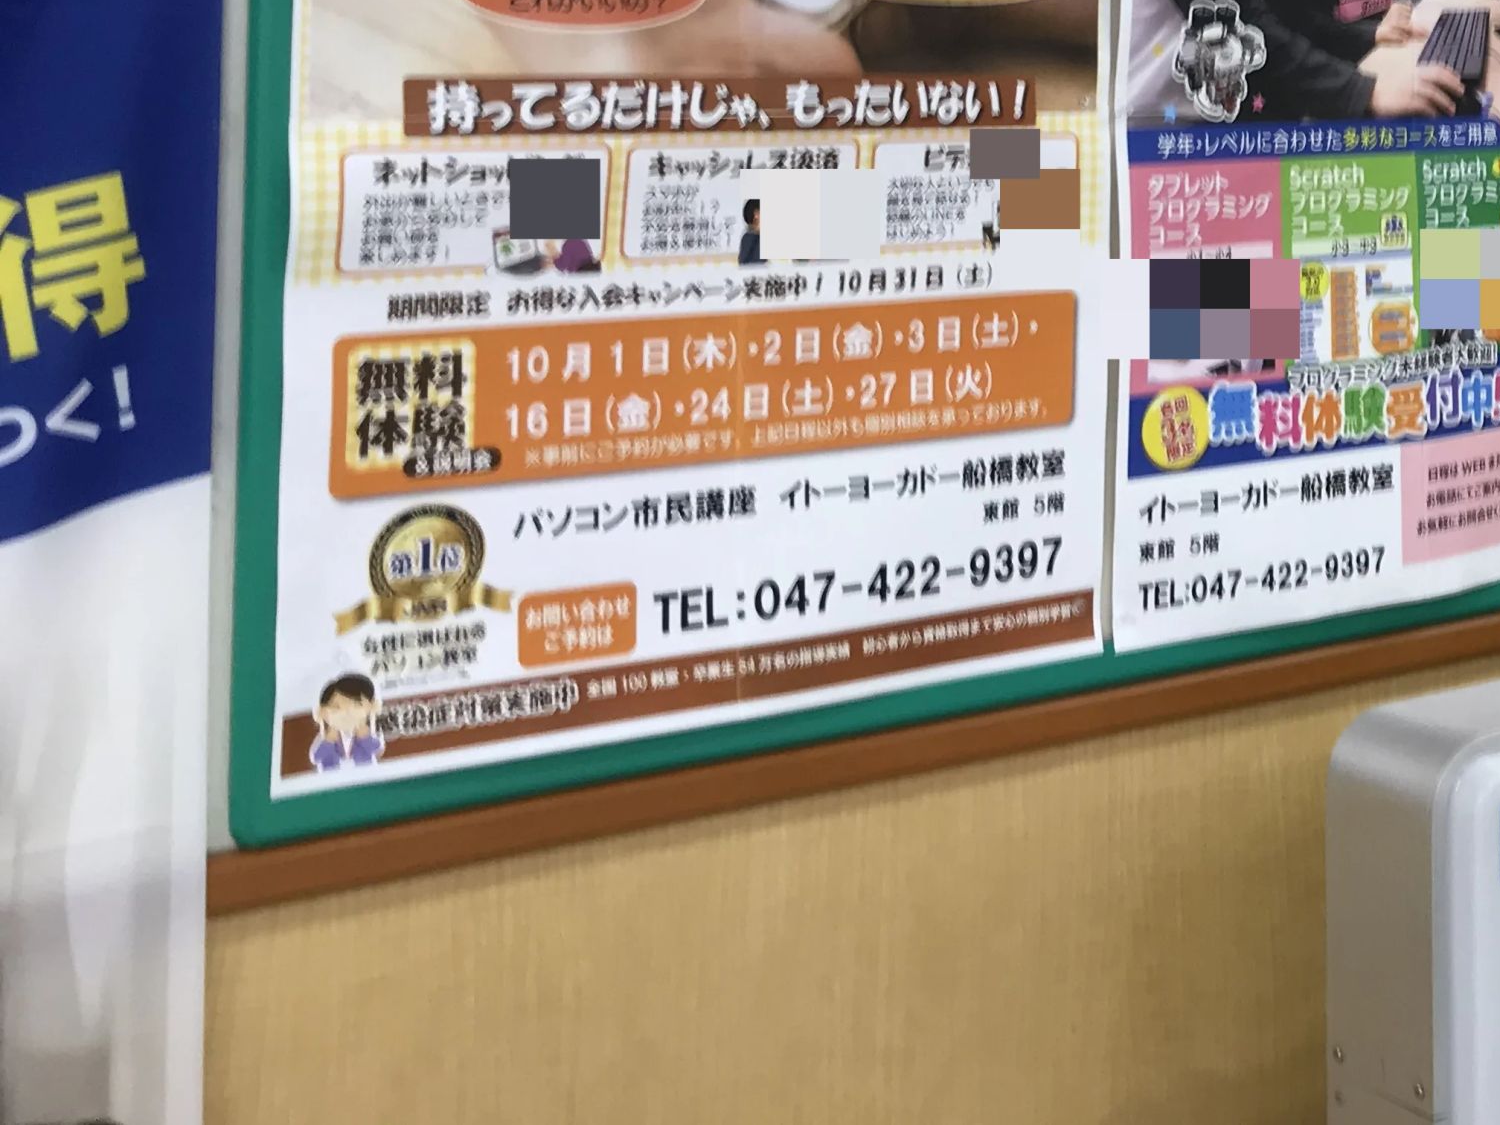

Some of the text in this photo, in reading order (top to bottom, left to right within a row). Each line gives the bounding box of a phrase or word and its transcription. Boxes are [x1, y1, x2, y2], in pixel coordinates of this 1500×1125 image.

[1289, 162, 1366, 189] Scratch
[1421, 155, 1488, 184] Scratch
[356, 349, 467, 407] 無料
[355, 400, 467, 458] 体験
[513, 449, 1067, 540] パソコン市民講座 イトーヨーカドー船橋教室
[982, 492, 1067, 525] 東館 5階
[1138, 463, 1395, 526] イトーヨーカドー船橋教室
[1138, 532, 1221, 564] 東館 5階
[653, 535, 1064, 635] TEL:047-422-9397
[1138, 546, 1386, 612] TEL:047-422-9397
